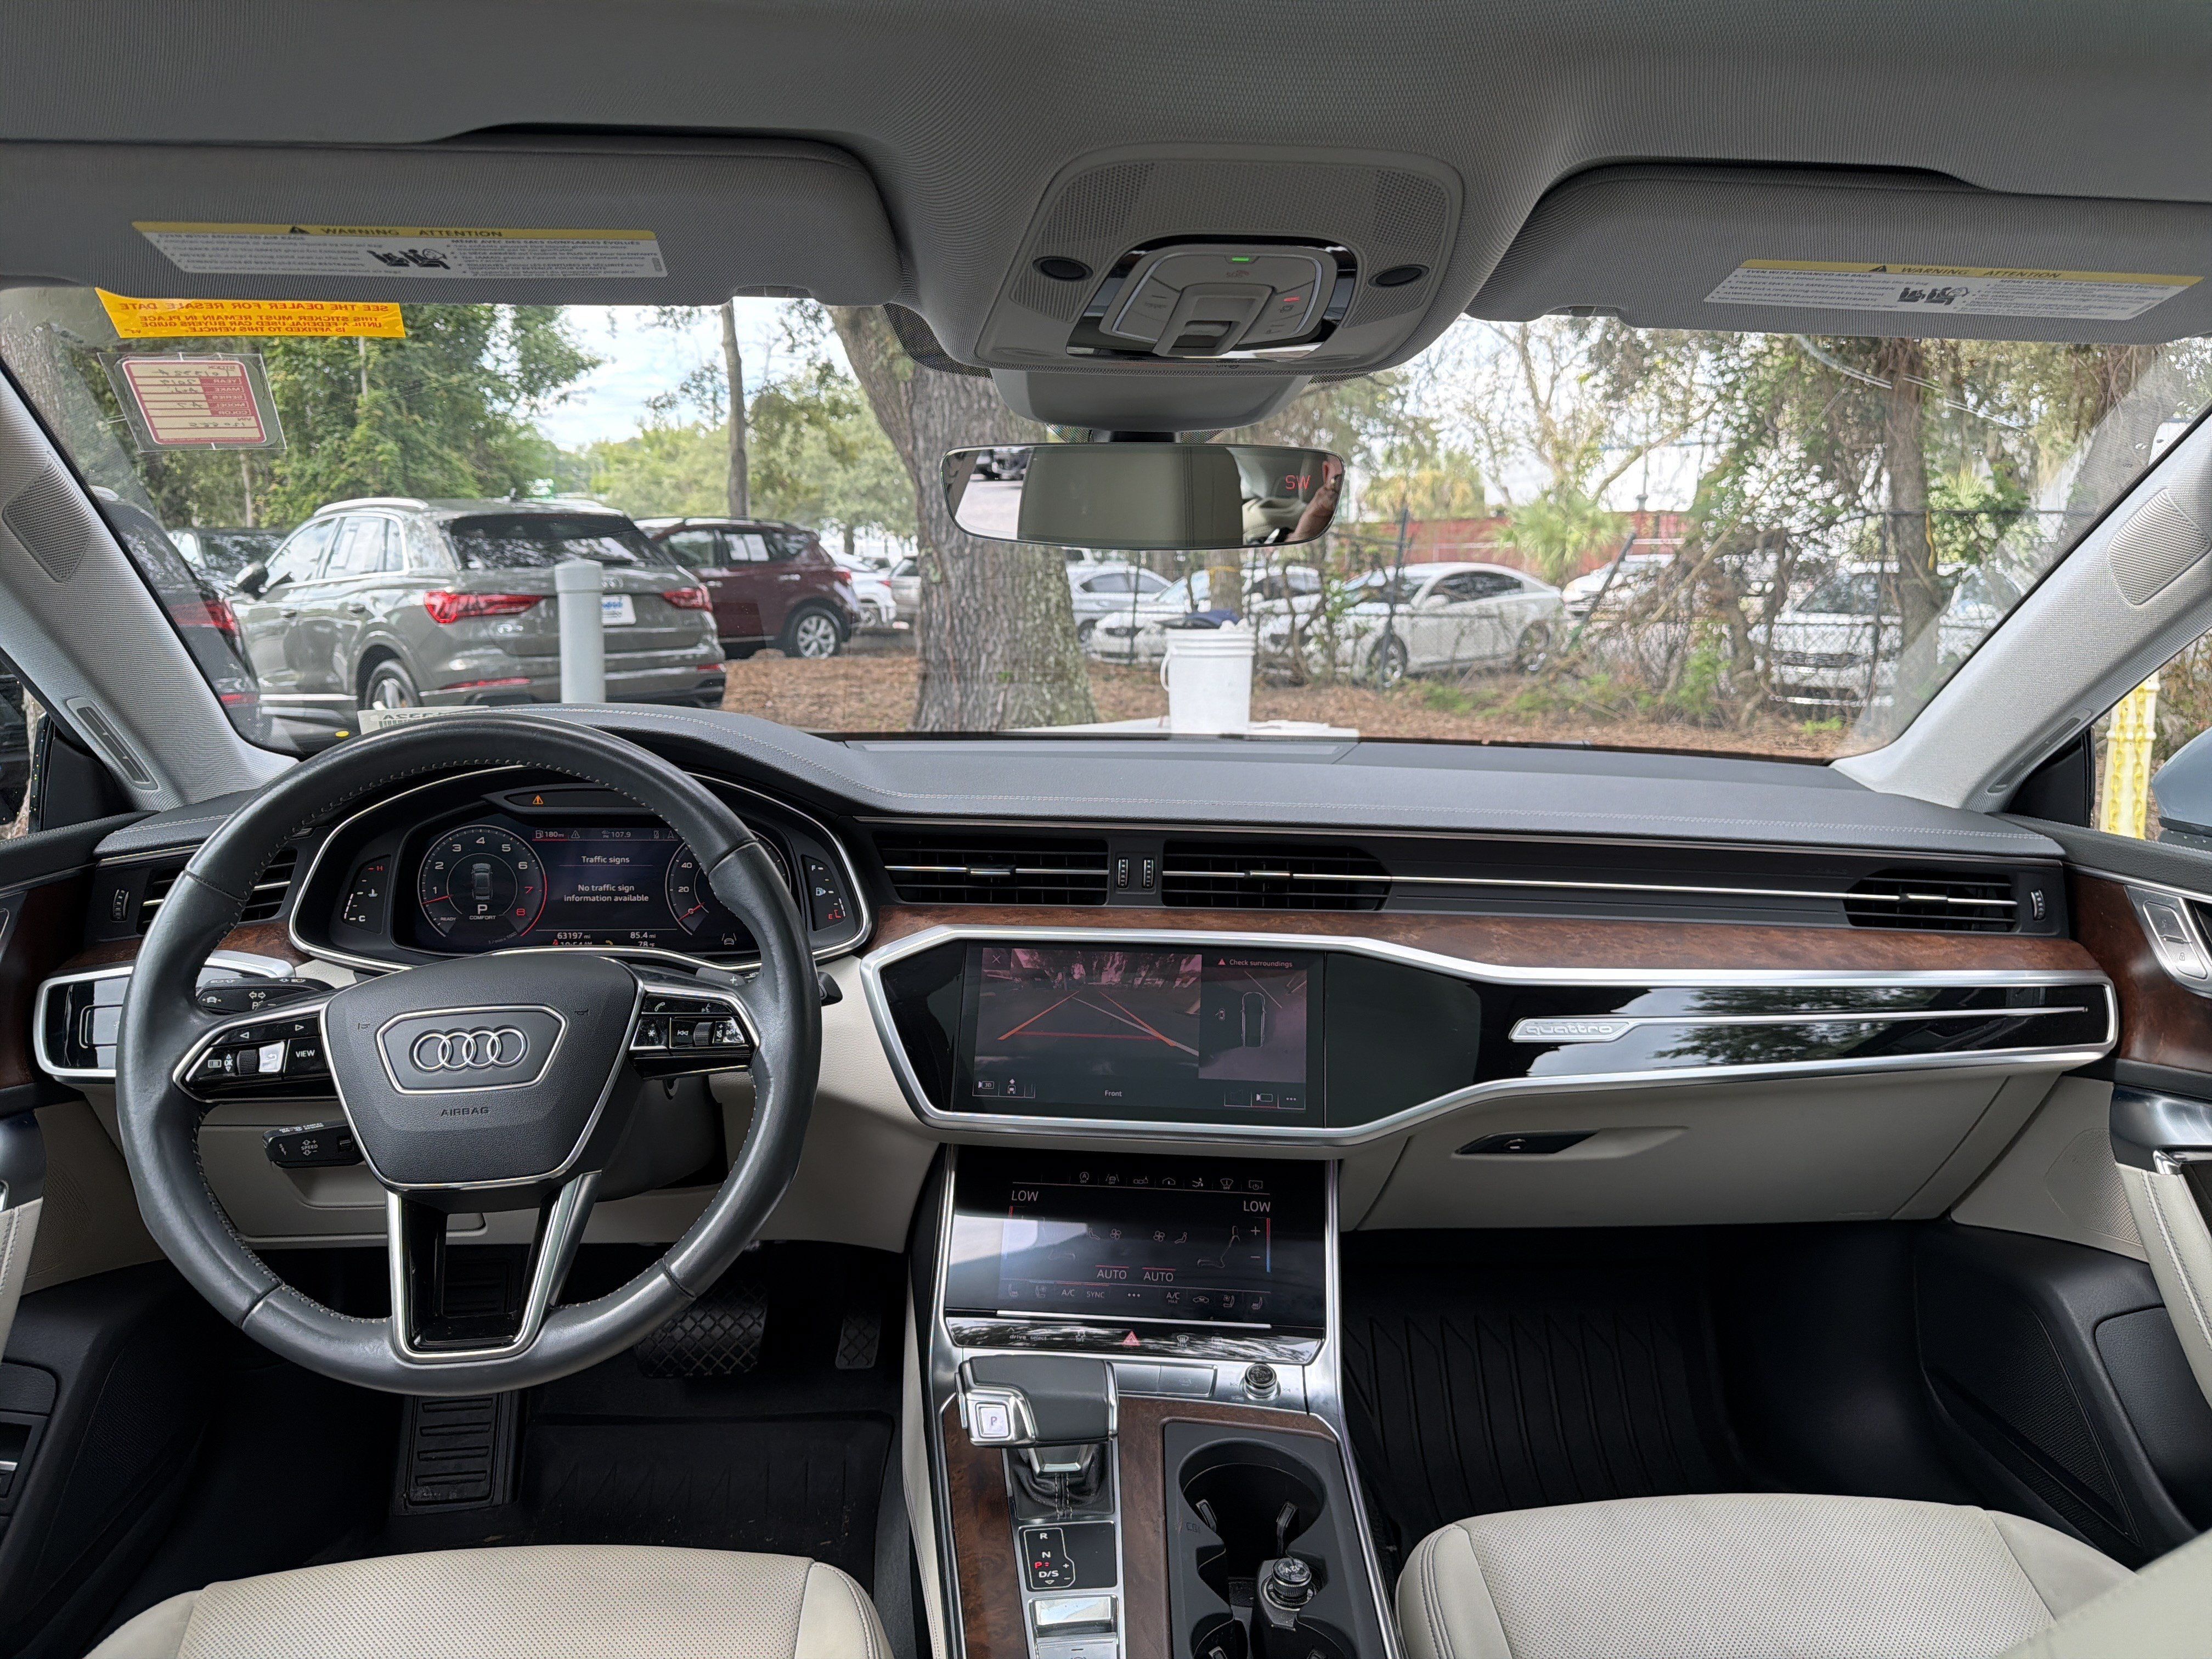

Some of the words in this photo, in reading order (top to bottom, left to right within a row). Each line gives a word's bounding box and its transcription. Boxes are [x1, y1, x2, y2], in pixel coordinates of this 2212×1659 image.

[1901, 267, 1970, 275] WARNING
[1983, 270, 2062, 279] ATTENTION
[1285, 474, 1311, 490] SW
[476, 836, 486, 845] 4
[452, 844, 462, 852] 3
[501, 844, 512, 853] 5
[581, 855, 607, 864] Traffic
[609, 856, 630, 866] signs
[680, 860, 692, 868] 40
[435, 861, 444, 870] 2
[518, 861, 528, 870] 6
[432, 886, 438, 895] 1
[524, 886, 534, 895] 7
[578, 884, 588, 892] No
[590, 883, 615, 892] traffic
[616, 884, 635, 893] sign
[678, 884, 690, 893] 20
[563, 894, 607, 902] information
[608, 894, 650, 902] available
[477, 904, 488, 915] P
[516, 908, 526, 917] 8
[1229, 958, 1249, 967] Check
[1249, 959, 1293, 968] surroundings
[1525, 1022, 1612, 1036] quattro
[295, 1049, 315, 1058] VIEW
[223, 1059, 233, 1068] OK
[1104, 1089, 1122, 1097] Front
[441, 1106, 490, 1118] AIRBAG
[1011, 1190, 1039, 1202] LOW
[1243, 1200, 1271, 1212] LOW
[1097, 1269, 1127, 1280] AUTO
[1143, 1271, 1174, 1282] AUTO
[1166, 1291, 1180, 1300] A/C
[990, 1416, 998, 1425] P
[1284, 1565, 1301, 1573] 12V
[1039, 1570, 1059, 1578] D/S
